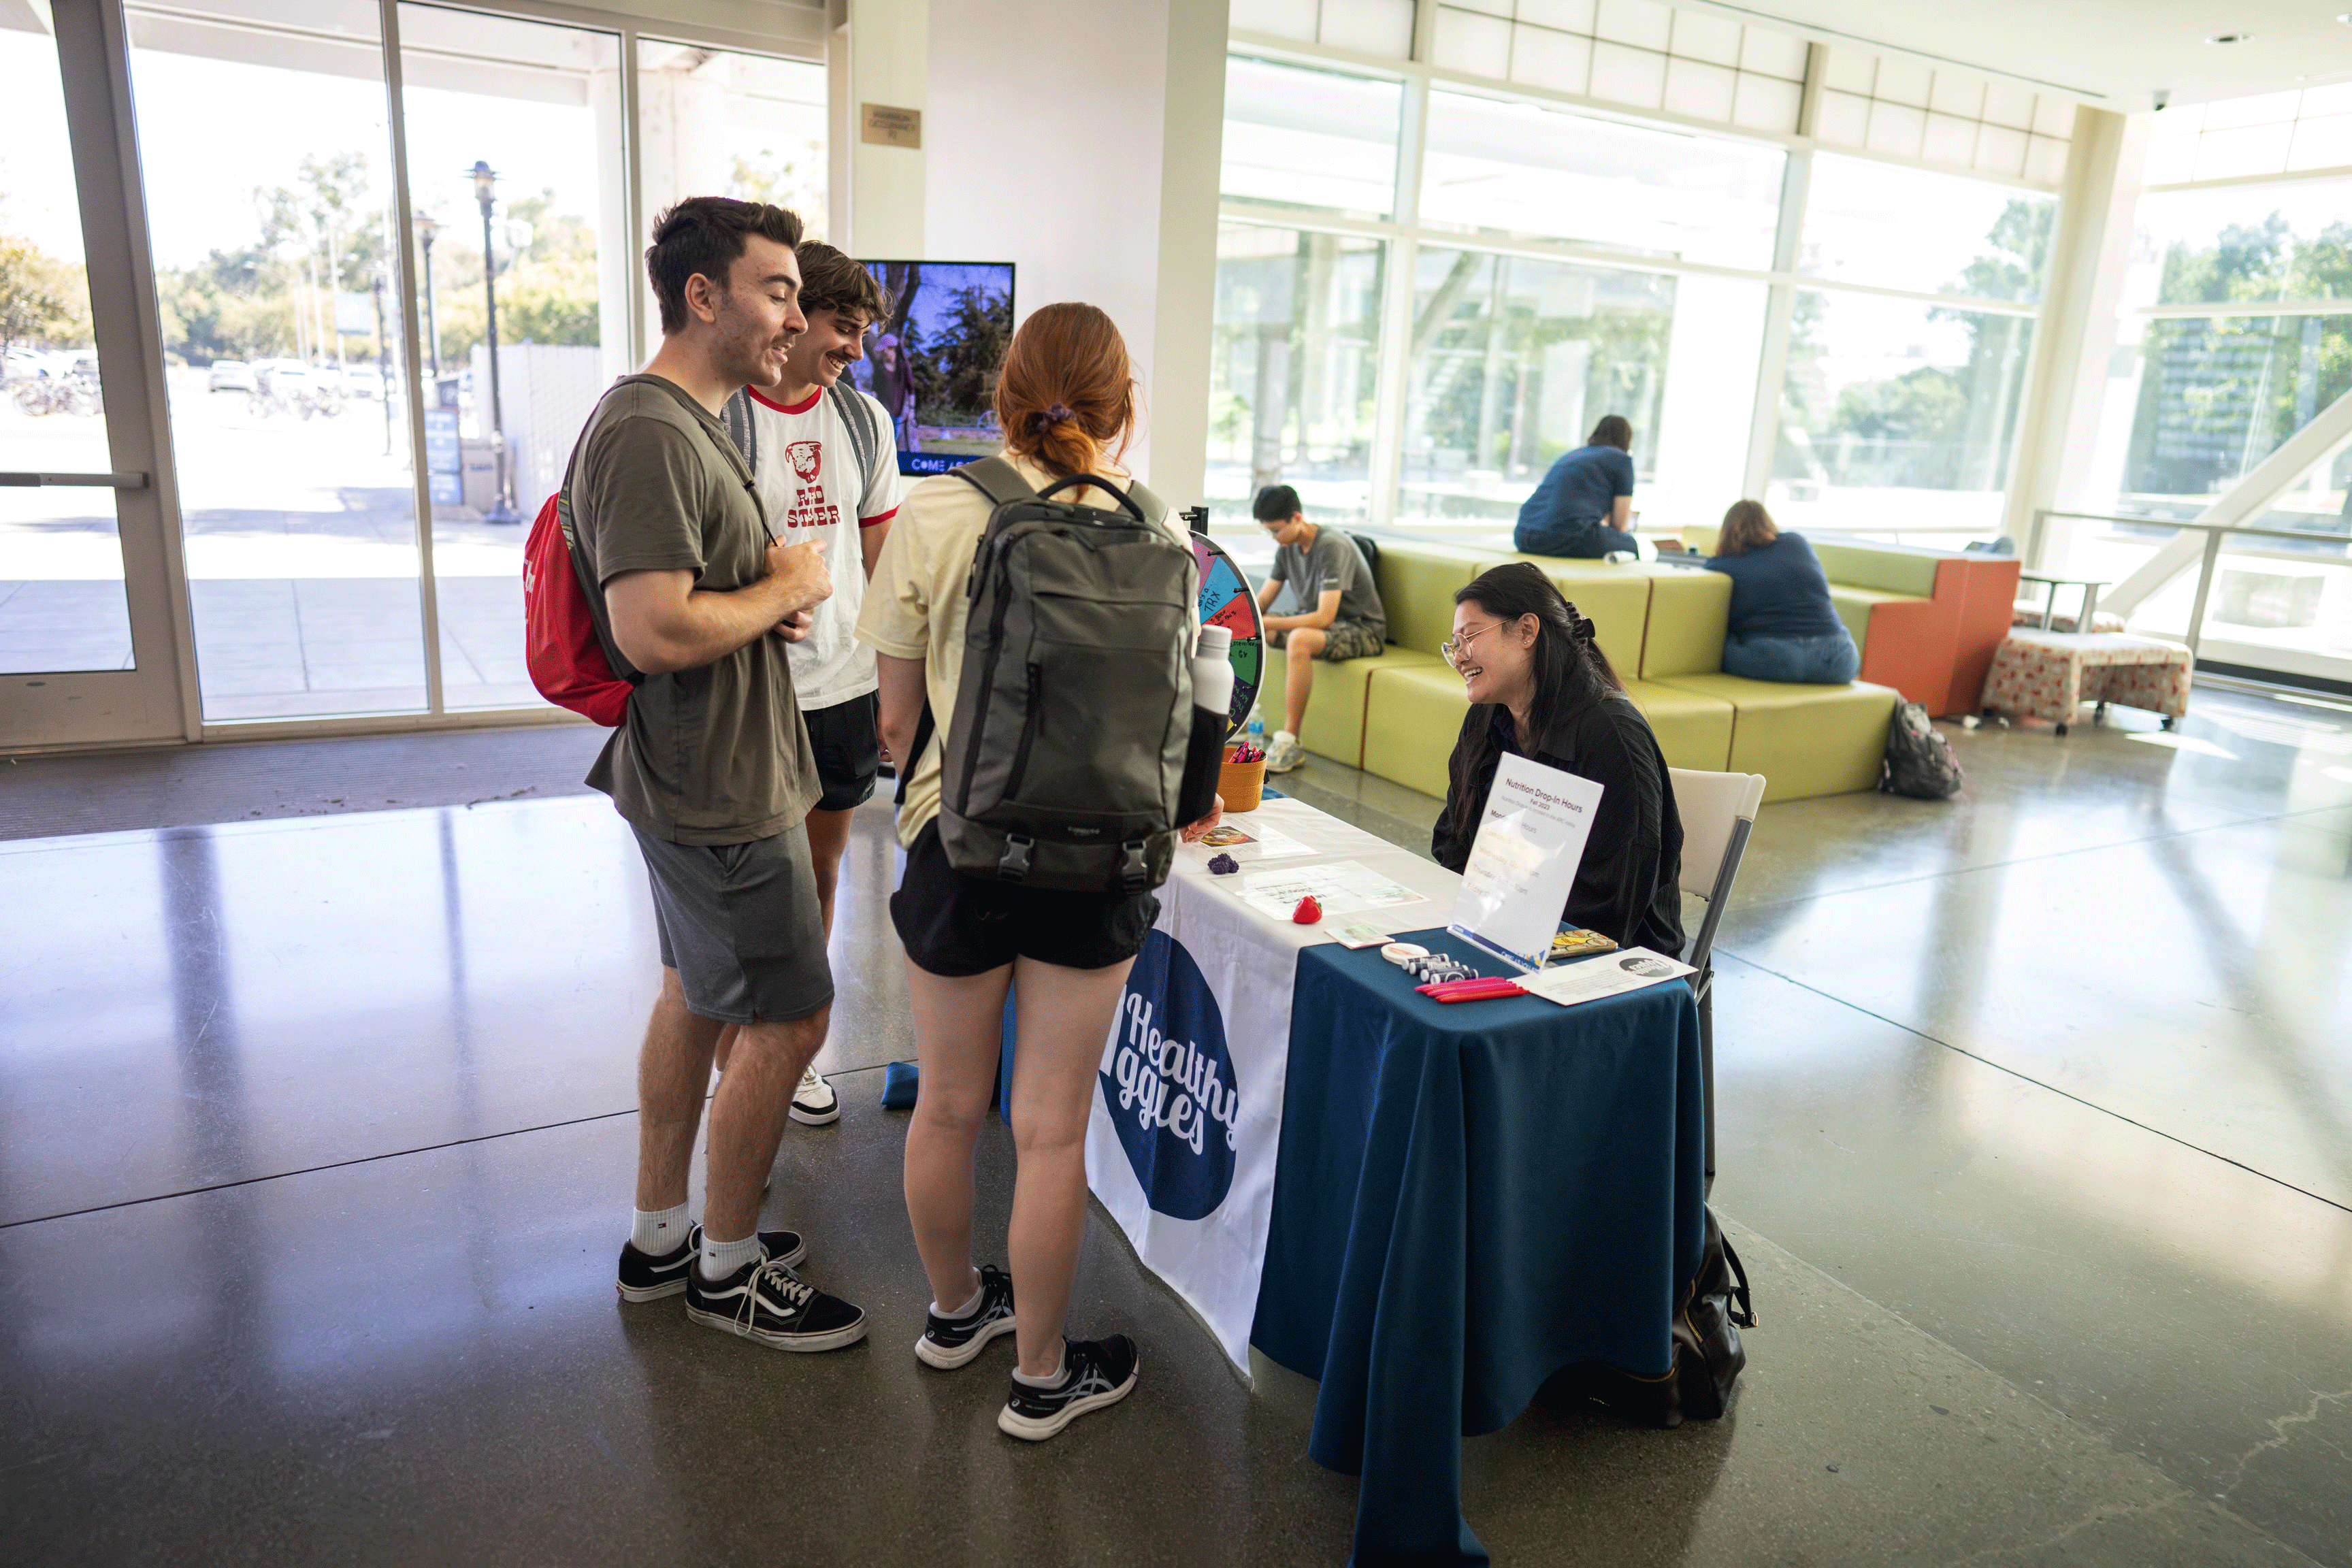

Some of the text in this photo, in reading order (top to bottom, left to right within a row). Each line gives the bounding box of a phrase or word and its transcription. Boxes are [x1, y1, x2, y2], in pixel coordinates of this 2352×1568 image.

[911, 459, 945, 472] COME
[1204, 591, 1220, 612] TRX
[1505, 778, 1583, 813] Nutrition Drop-In Hours
[1538, 802, 1550, 811] 2023
[1521, 821, 1537, 833] Hours
[1126, 993, 1239, 1152] Healthy
